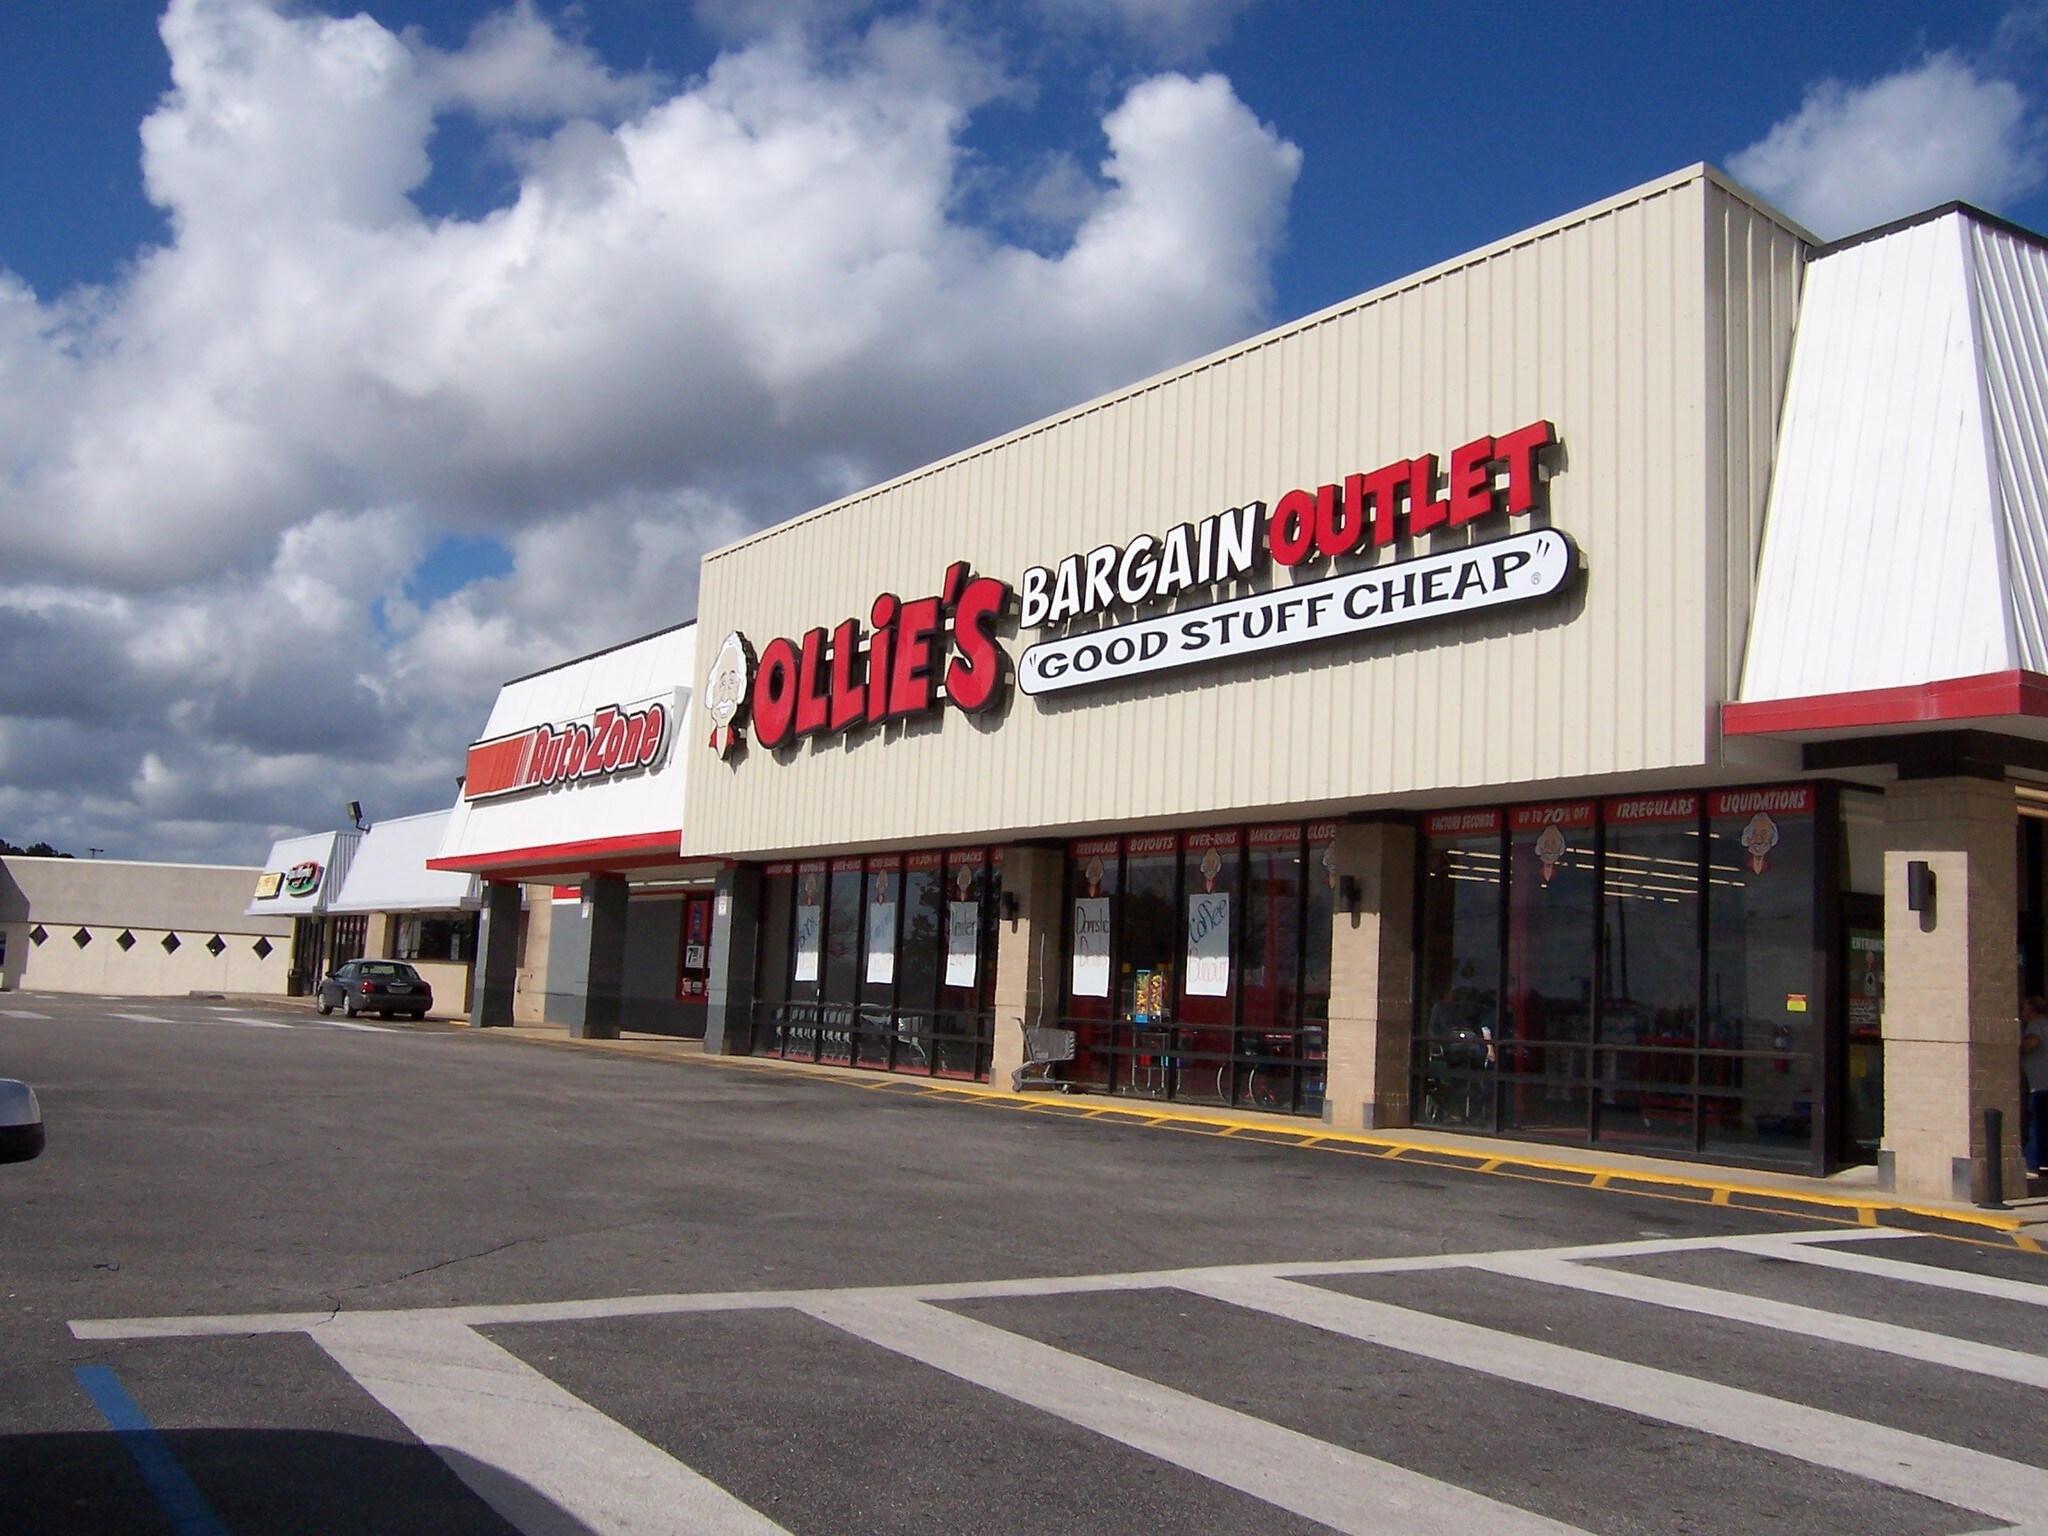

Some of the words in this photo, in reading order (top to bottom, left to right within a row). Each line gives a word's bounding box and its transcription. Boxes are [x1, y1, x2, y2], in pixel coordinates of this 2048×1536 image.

[1019, 501, 1262, 630] BARGAIN
[1269, 419, 1553, 567] OUTLET
[1181, 593, 1334, 651] STUFF
[526, 706, 665, 786] AutoZone
[1616, 798, 1695, 818] IRREGULARS
[1720, 790, 1807, 813] LIQUIDATIONS
[1518, 812, 1529, 824] UP
[1532, 811, 1542, 822] TO
[1574, 806, 1589, 820] OFF
[1130, 837, 1174, 851] BUYOUTS
[1188, 831, 1237, 846] OVER-RUNS
